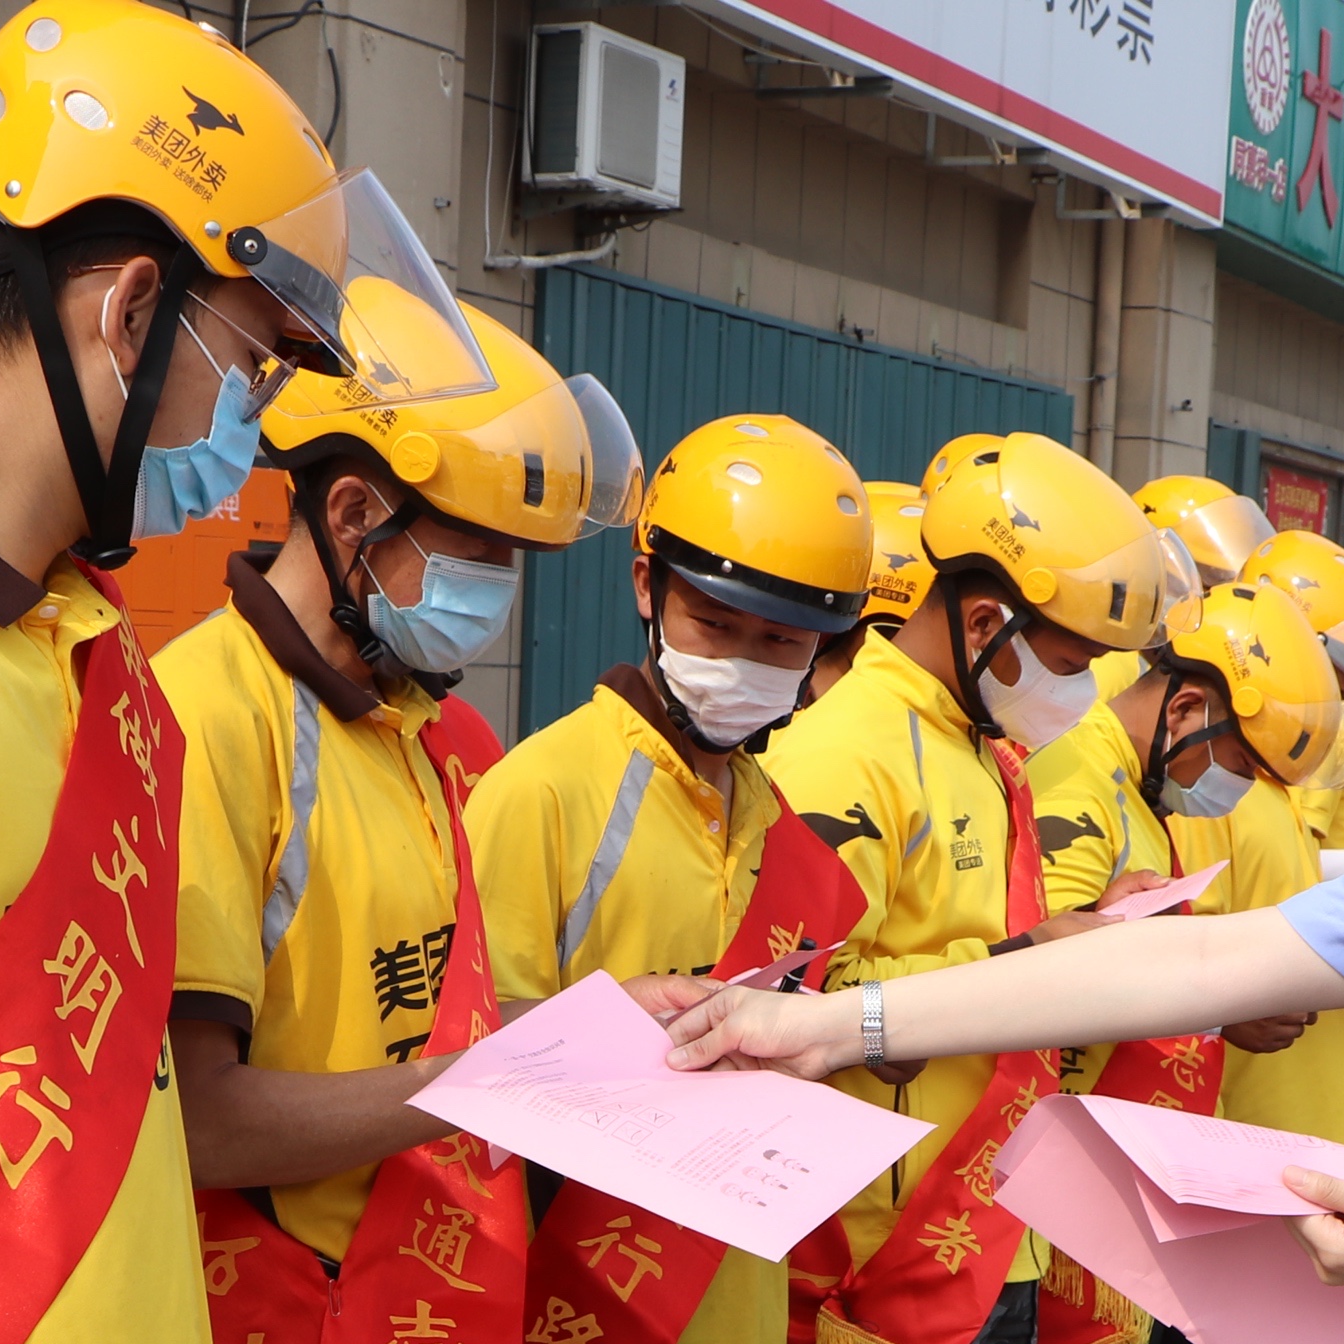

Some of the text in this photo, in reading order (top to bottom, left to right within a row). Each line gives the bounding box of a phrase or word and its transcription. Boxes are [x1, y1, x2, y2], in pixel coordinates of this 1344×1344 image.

[130, 135, 215, 204] 美团外卖 送啥都快
[138, 114, 228, 192] 美团外卖
[985, 517, 1026, 559] 美团外卖
[869, 573, 917, 594] 美团外卖
[949, 838, 984, 860] 美团外卖
